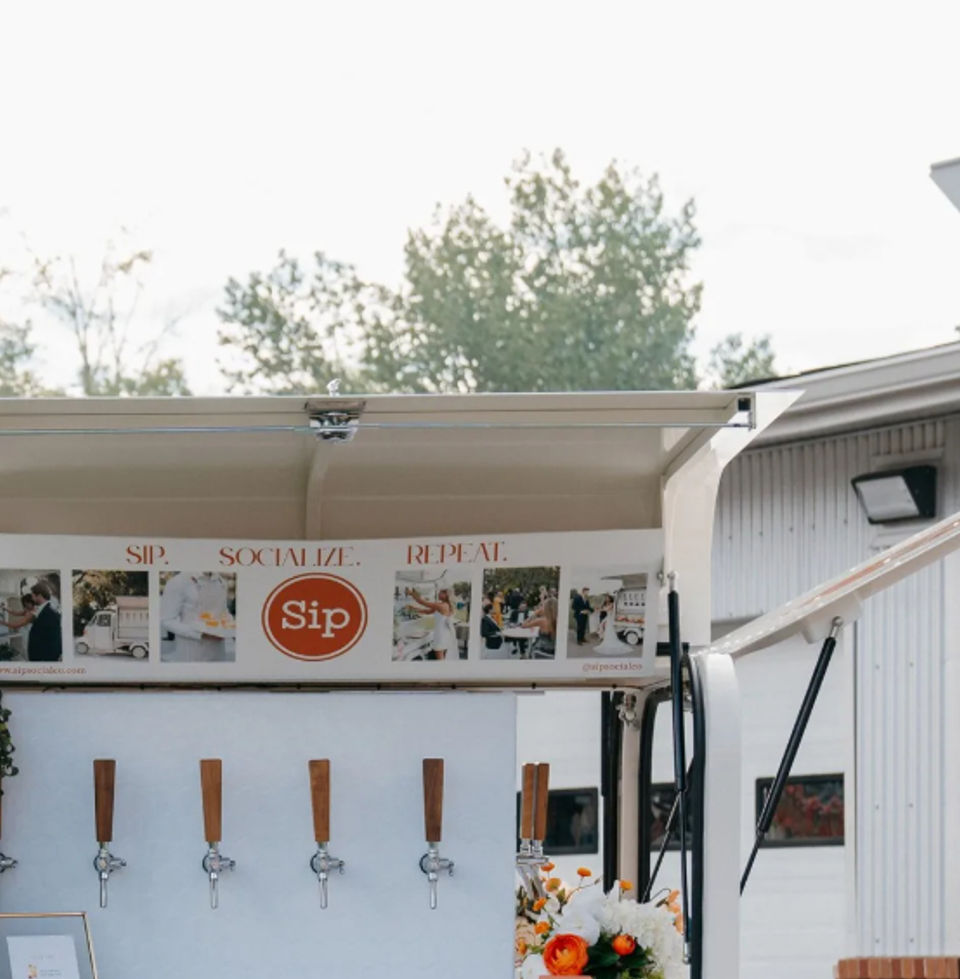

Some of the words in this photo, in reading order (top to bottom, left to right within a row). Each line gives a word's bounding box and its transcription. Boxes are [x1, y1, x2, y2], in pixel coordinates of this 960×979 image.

[125, 544, 169, 565] SIP.
[218, 546, 361, 567] SOCIALIZE.
[406, 541, 508, 565] REPEAT.
[281, 600, 351, 639] Sip
